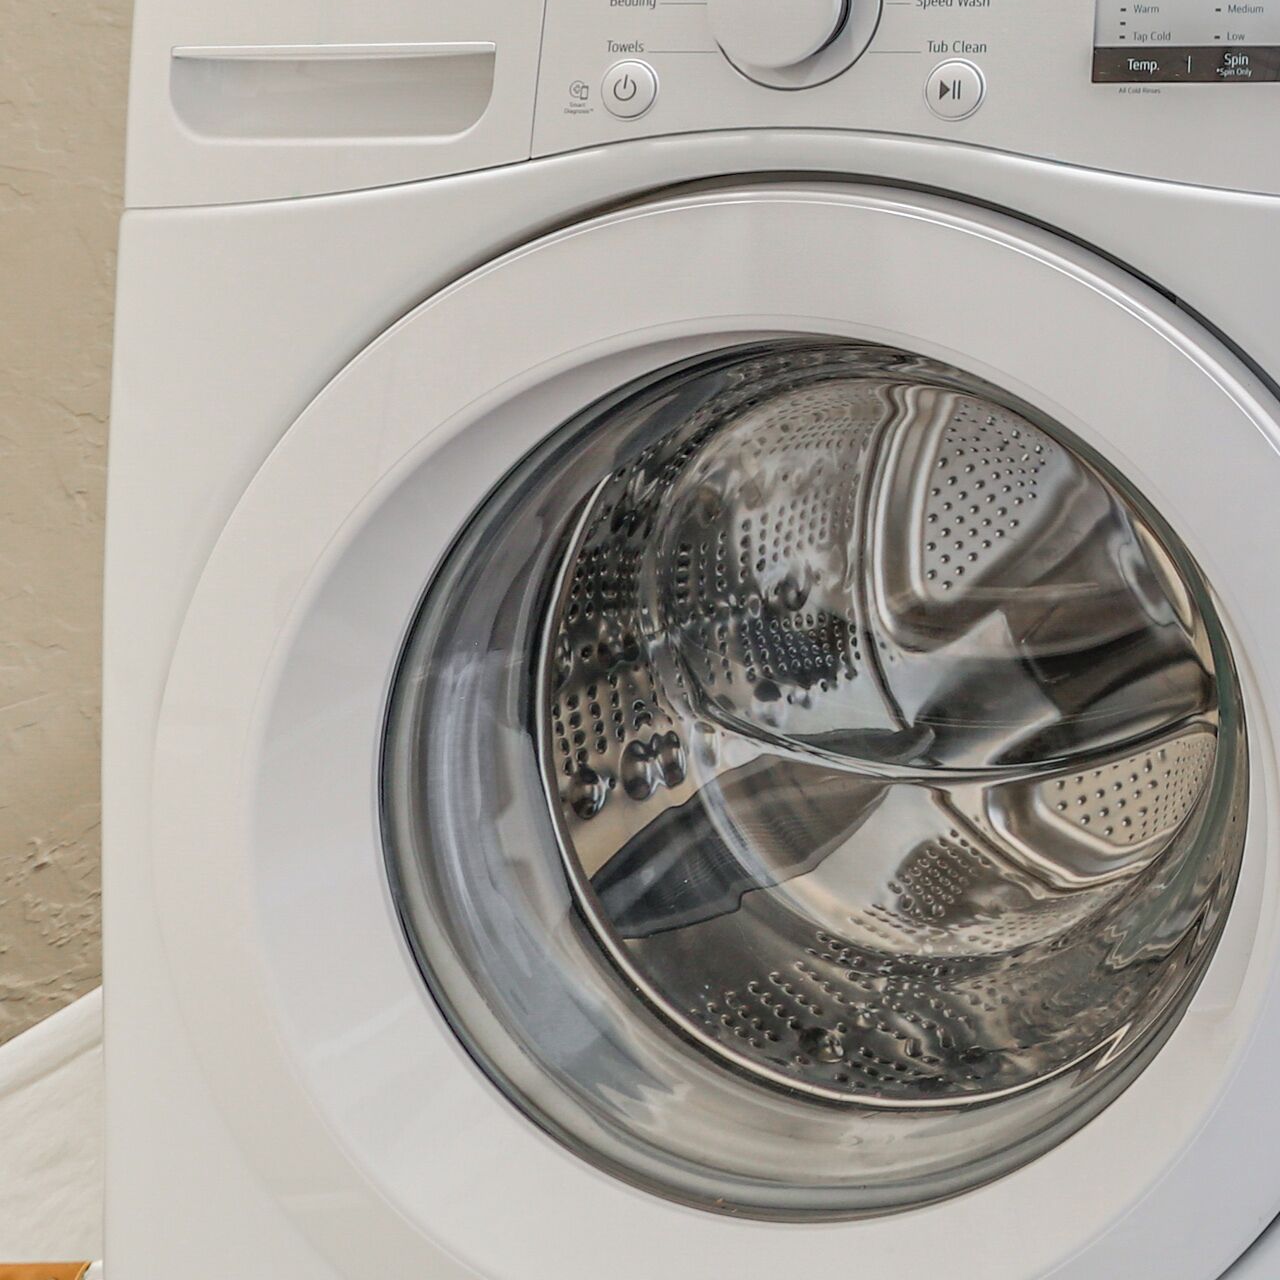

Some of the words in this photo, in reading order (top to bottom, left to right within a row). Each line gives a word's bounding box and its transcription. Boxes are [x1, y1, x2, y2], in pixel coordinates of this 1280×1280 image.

[1133, 5, 1159, 13] Warm
[1228, 5, 1264, 13] Medium
[1133, 32, 1148, 42] Tap
[1150, 32, 1171, 41] Cold
[1227, 32, 1245, 41] Low
[606, 40, 645, 53] Towels
[927, 40, 949, 53] Tub
[952, 40, 987, 53] Clean
[1224, 53, 1249, 67] Spin
[1127, 58, 1160, 73] Temp.
[1236, 68, 1252, 77] Only
